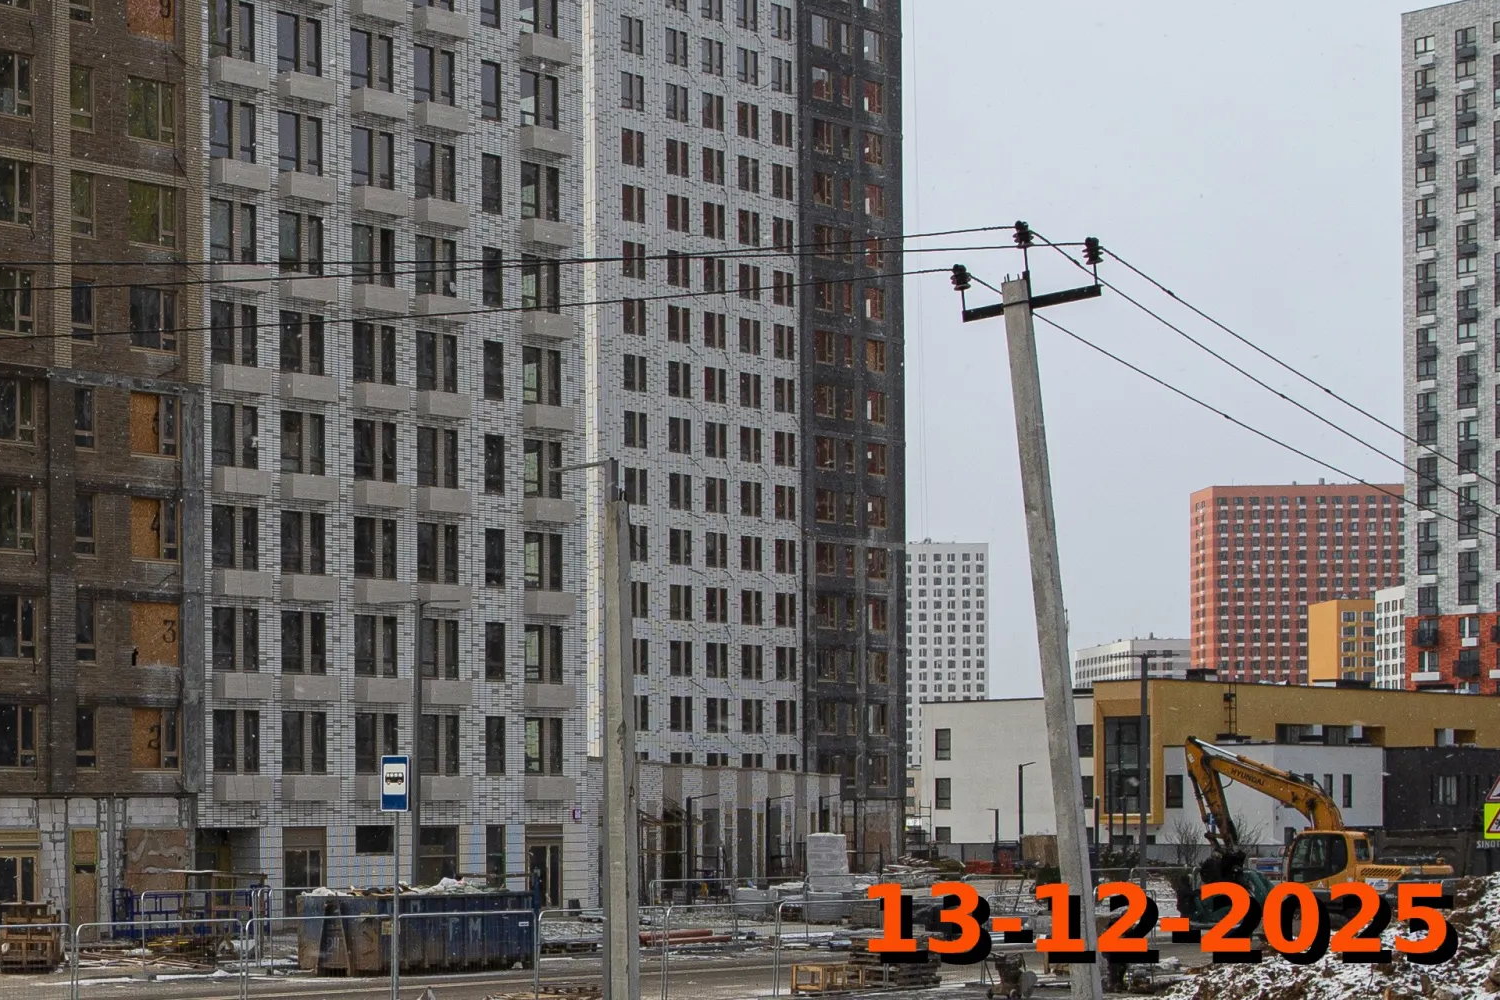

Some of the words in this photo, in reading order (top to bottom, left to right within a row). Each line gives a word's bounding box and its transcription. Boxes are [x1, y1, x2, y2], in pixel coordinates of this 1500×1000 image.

[162, 619, 176, 644] 3
[147, 724, 161, 750] 2
[1230, 767, 1265, 786] HYUNDAI
